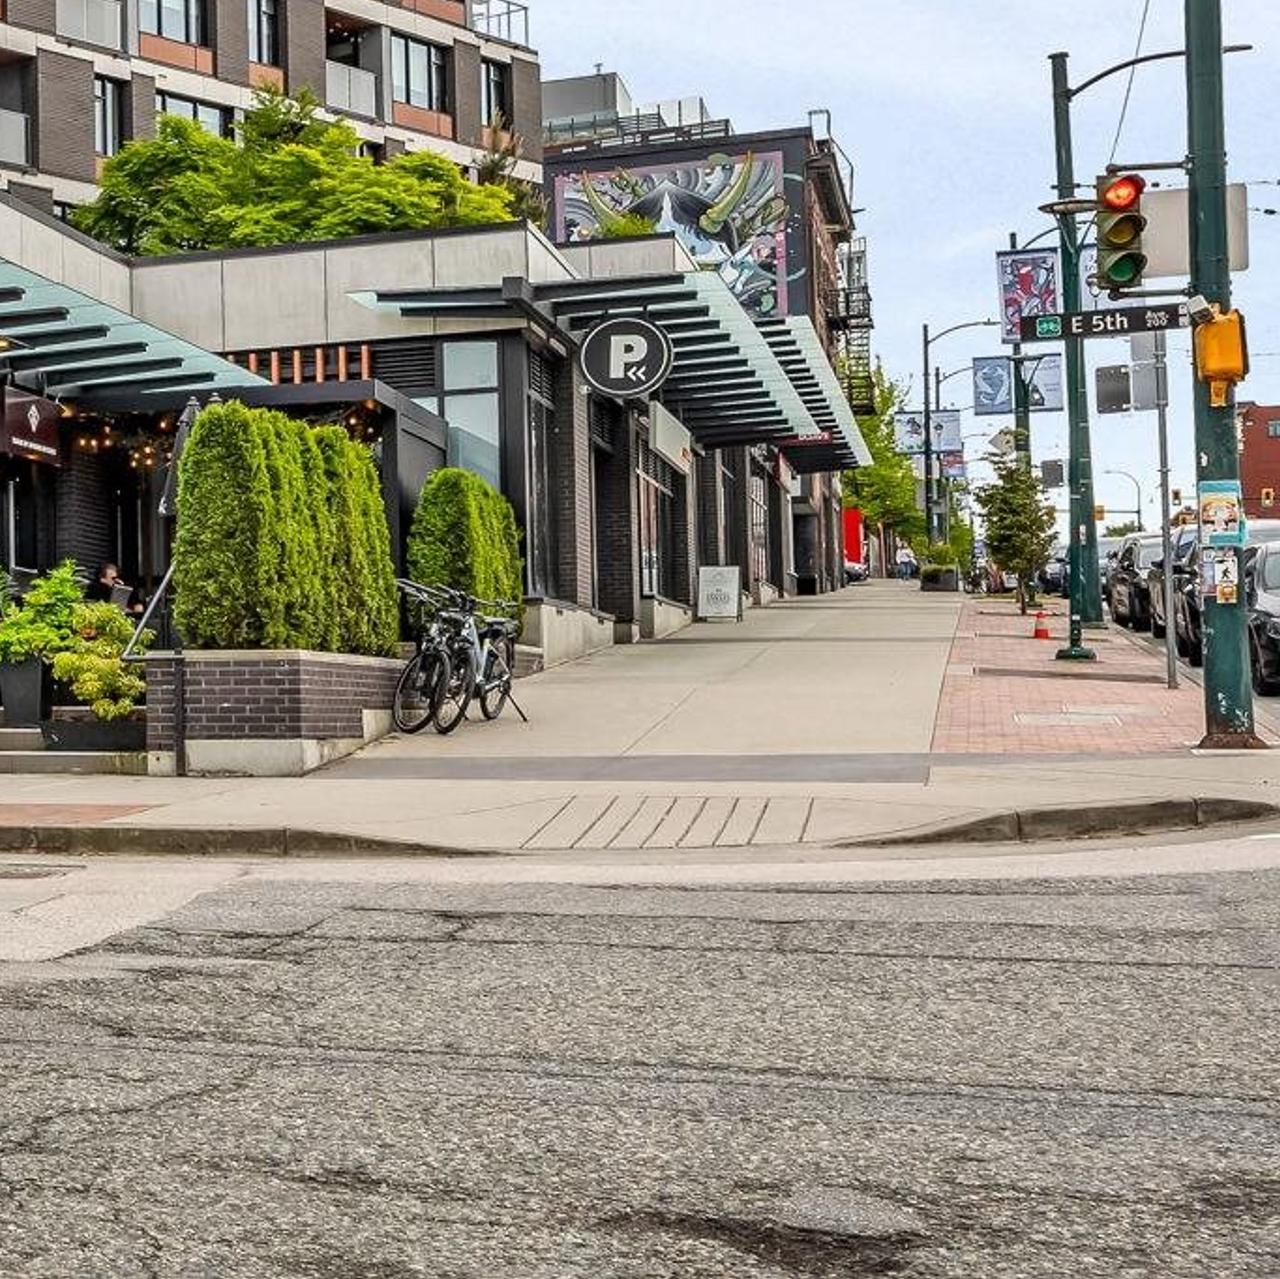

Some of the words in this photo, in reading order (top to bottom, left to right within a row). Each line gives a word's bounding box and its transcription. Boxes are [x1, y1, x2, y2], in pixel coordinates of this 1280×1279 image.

[1071, 316, 1084, 334] E
[1092, 312, 1128, 332] 5th
[609, 334, 648, 379] P
